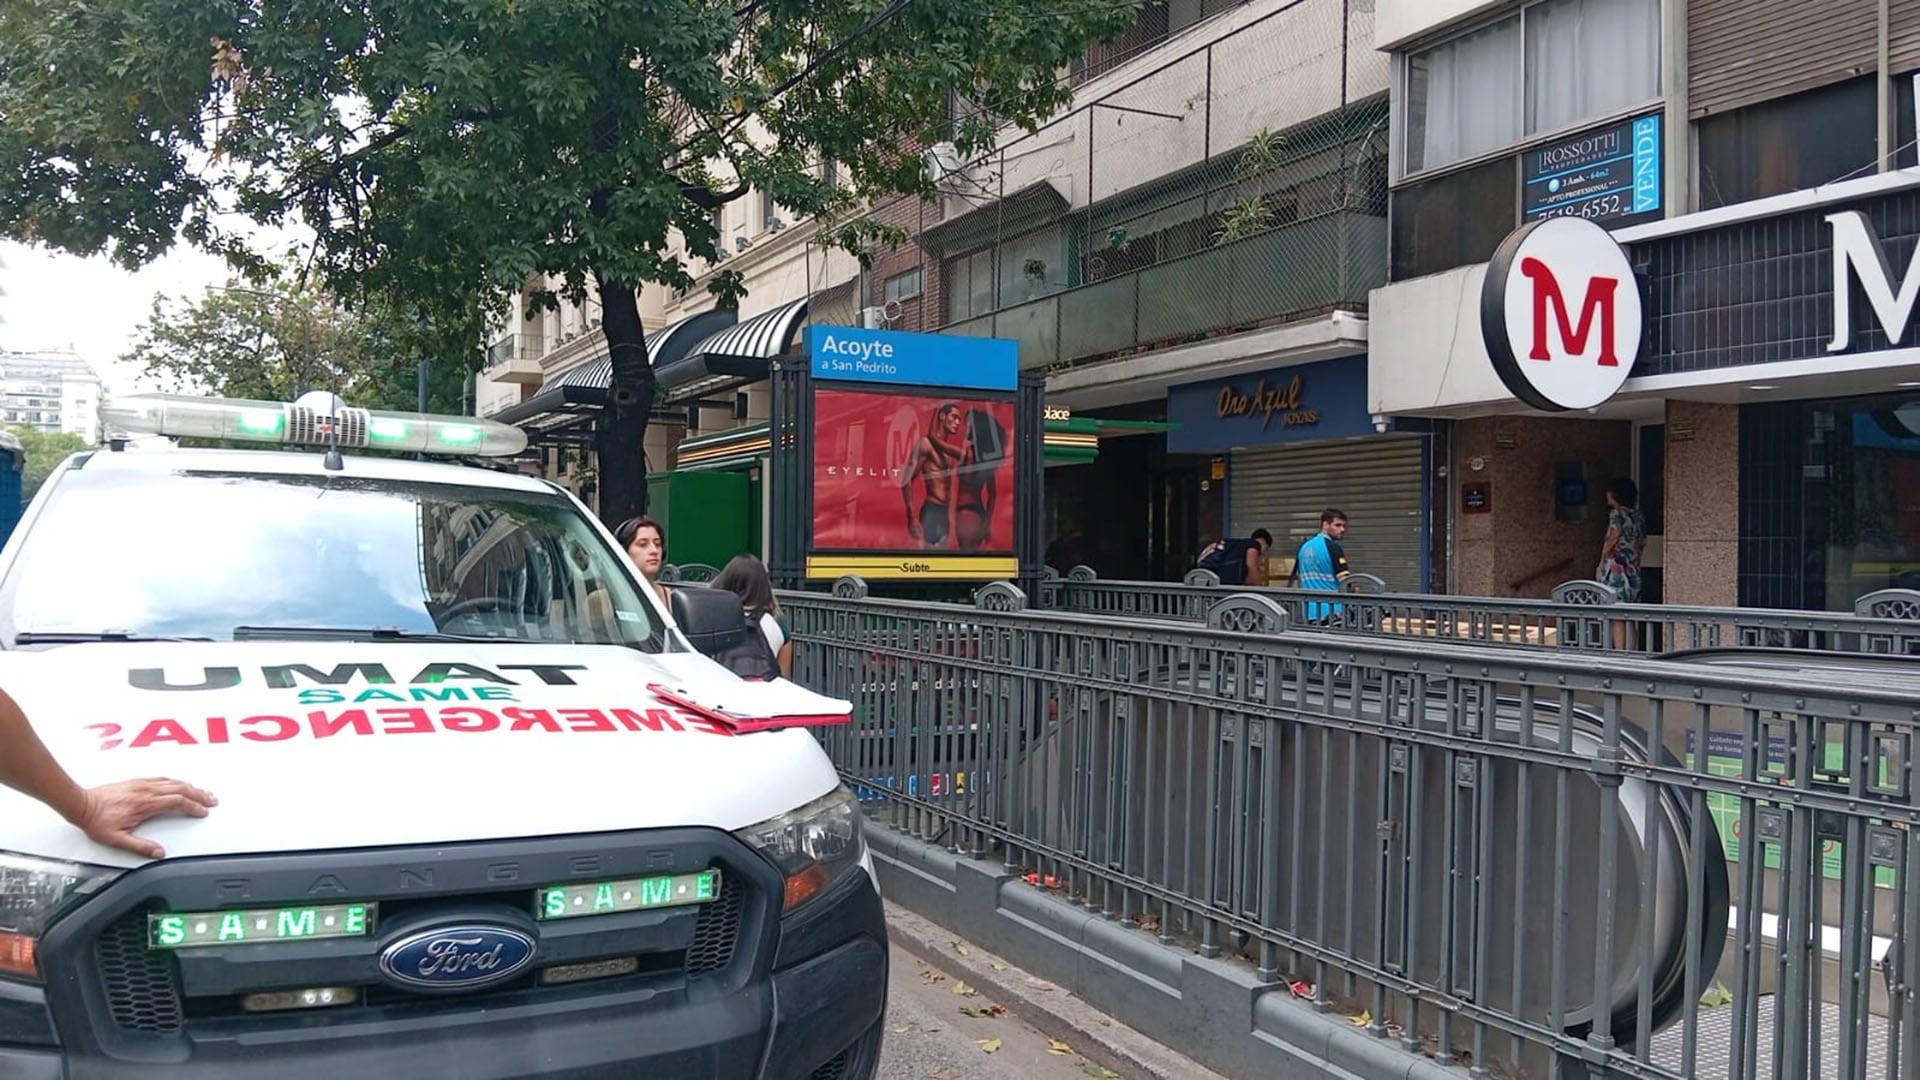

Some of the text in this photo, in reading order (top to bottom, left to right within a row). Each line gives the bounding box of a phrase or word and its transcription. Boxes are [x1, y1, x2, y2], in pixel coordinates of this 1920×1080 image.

[1543, 132, 1615, 165] ROSSOTTI
[1637, 117, 1655, 211] VENDE
[1521, 257, 1619, 367] M
[822, 335, 894, 361] Acoyte
[821, 359, 897, 375] a San Pedrito
[1247, 374, 1302, 432] Azul
[826, 465, 902, 478] EYELIT
[902, 562, 931, 574] Subte
[128, 662, 589, 691] UMAT
[297, 687, 521, 705] SAME
[215, 850, 675, 898] RANGER
[418, 936, 504, 976] Ford
